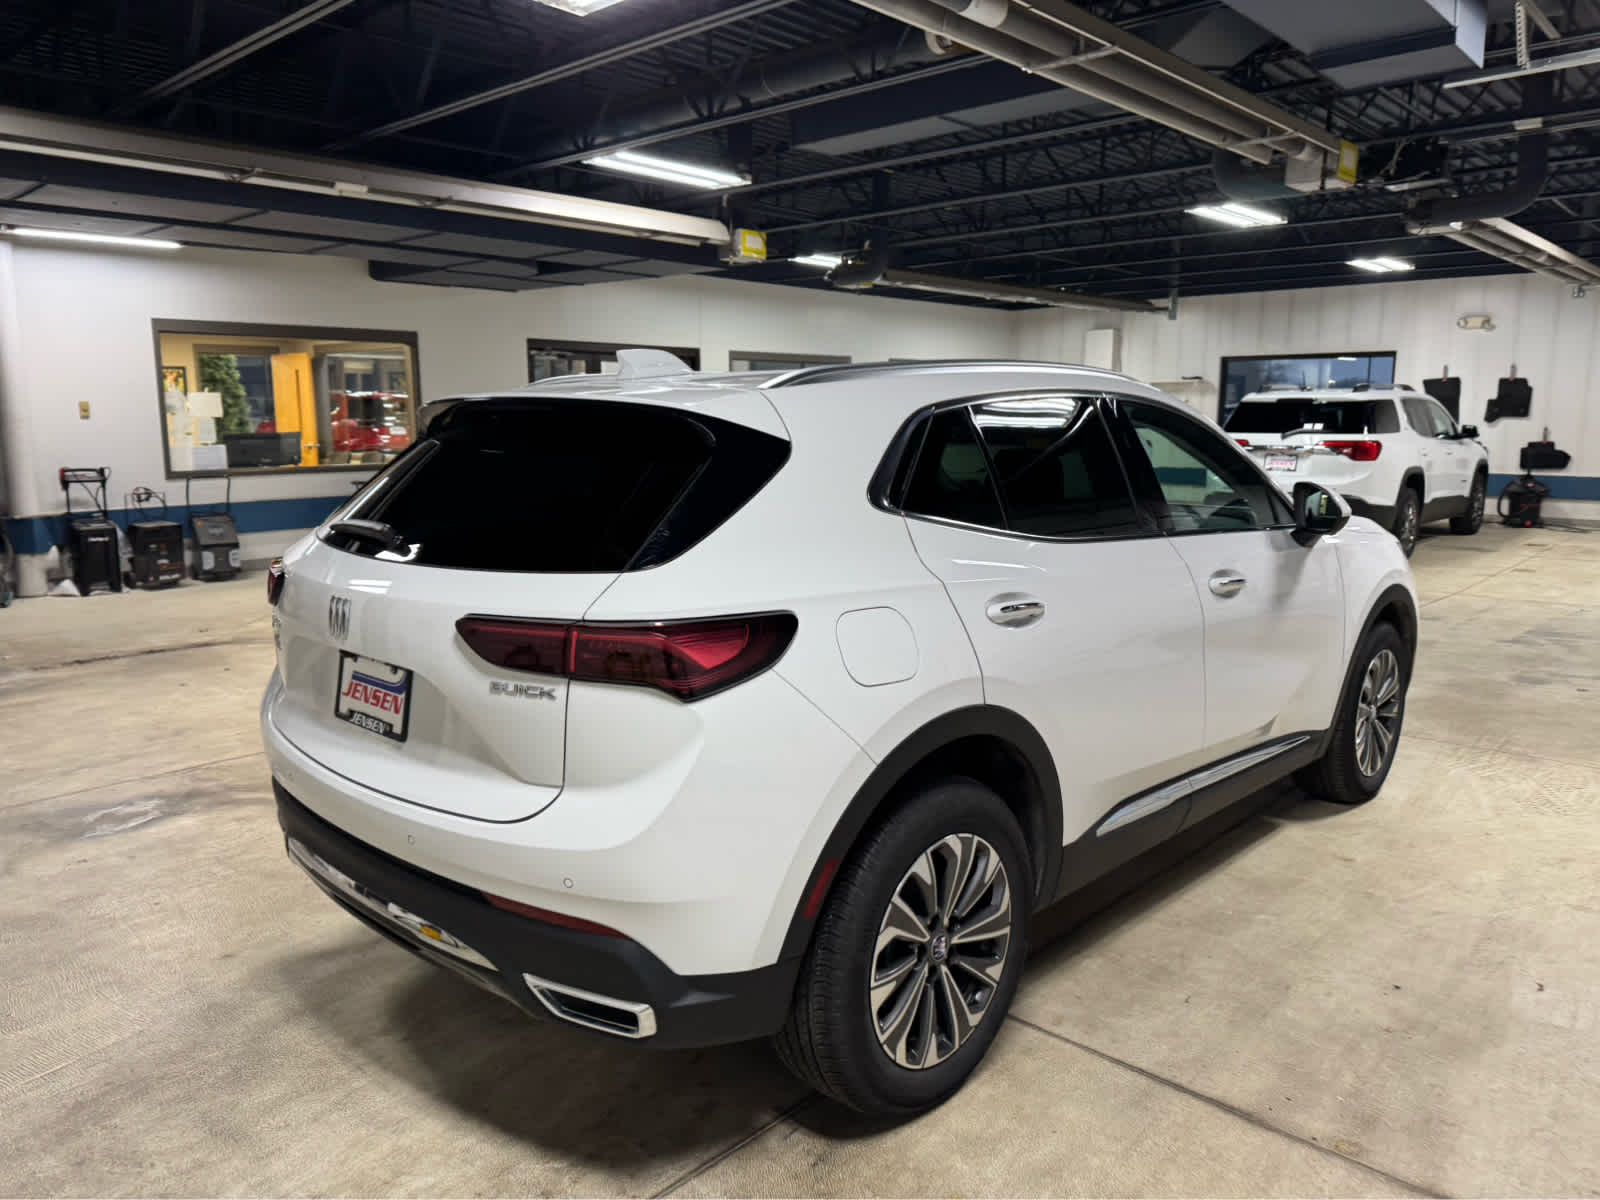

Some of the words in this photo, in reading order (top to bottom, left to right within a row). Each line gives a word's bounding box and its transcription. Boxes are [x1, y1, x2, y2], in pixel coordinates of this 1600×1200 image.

[342, 681, 405, 715] JENSEN
[489, 681, 557, 701] BUICK
[350, 712, 385, 734] JENSEN
